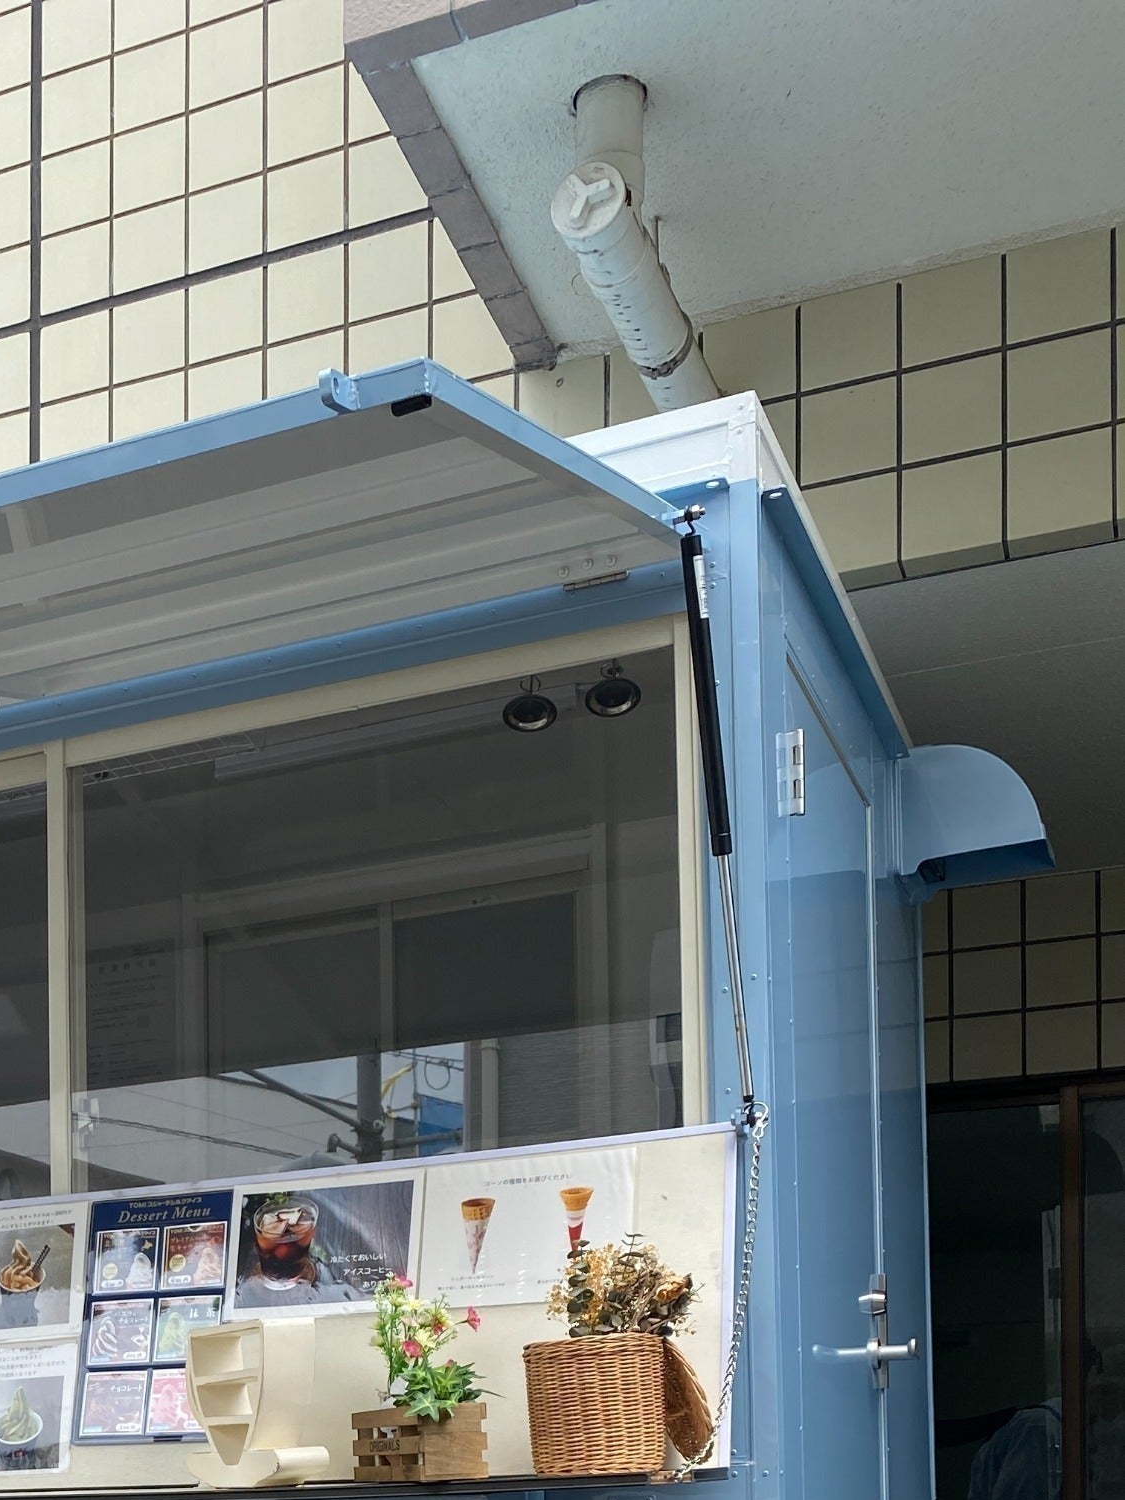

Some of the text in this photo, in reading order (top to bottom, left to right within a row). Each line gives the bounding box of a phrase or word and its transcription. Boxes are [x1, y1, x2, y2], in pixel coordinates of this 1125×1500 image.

[117, 1205, 211, 1224] Dessert Menu
[330, 1252, 387, 1263] 冷たくておいしい
[343, 1266, 393, 1276] アイスコーヒー
[111, 1384, 143, 1393] チョコレート
